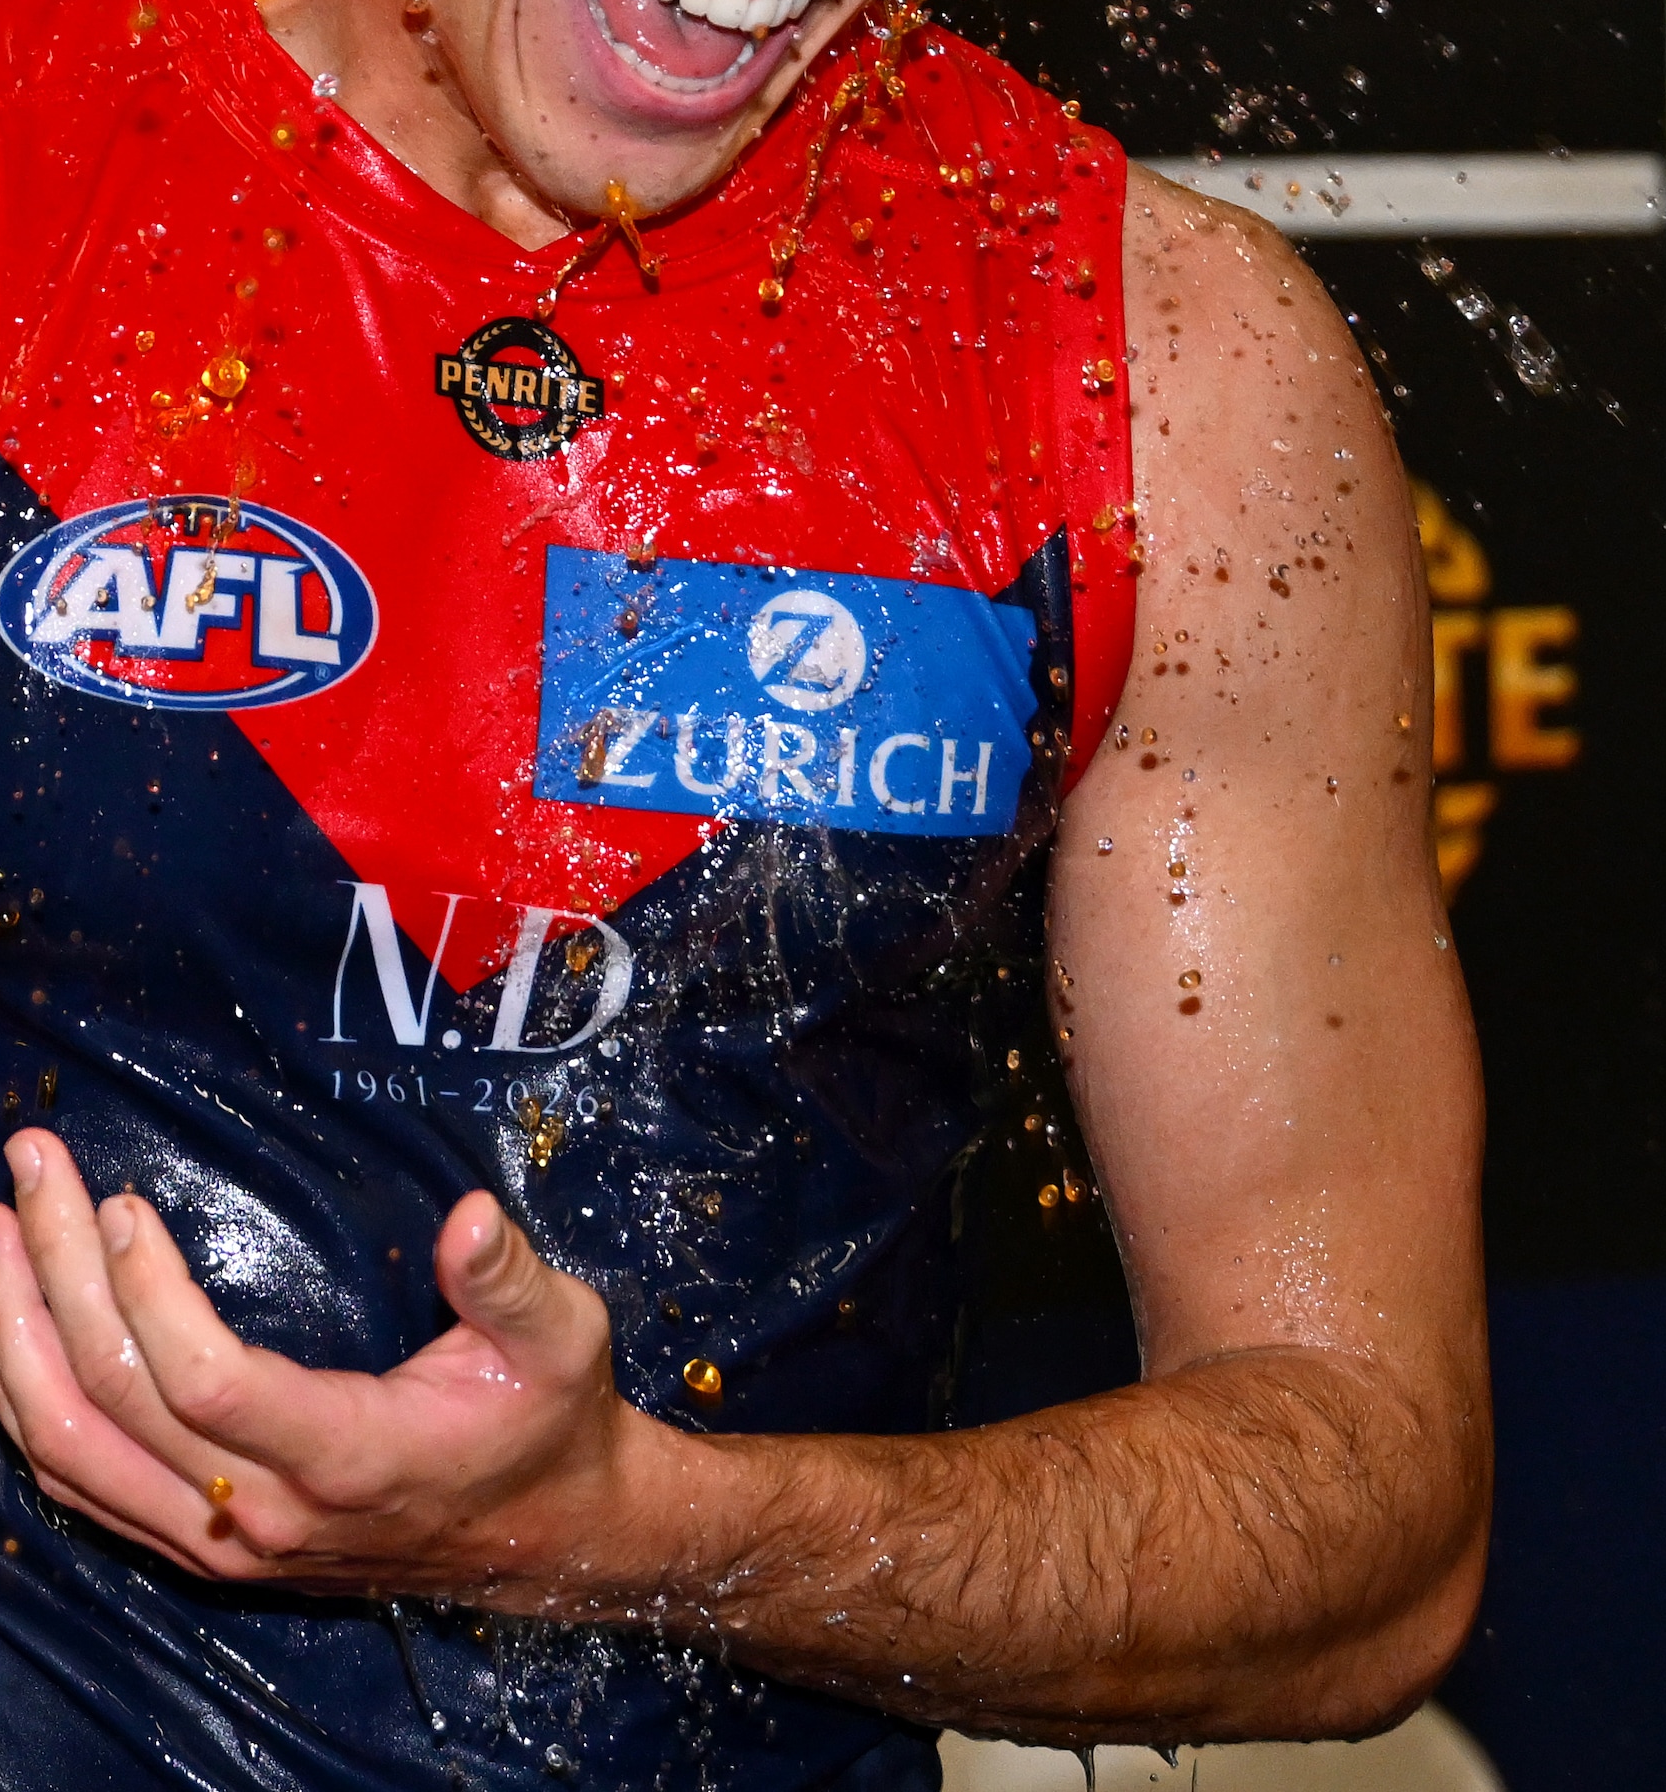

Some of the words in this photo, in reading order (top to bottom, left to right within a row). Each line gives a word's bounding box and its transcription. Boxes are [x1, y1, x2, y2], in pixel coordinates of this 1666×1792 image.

[441, 360, 596, 413] PENRITE
[26, 545, 342, 665] AFL
[595, 707, 993, 815] ZURICH
[318, 880, 633, 1057] N.D.
